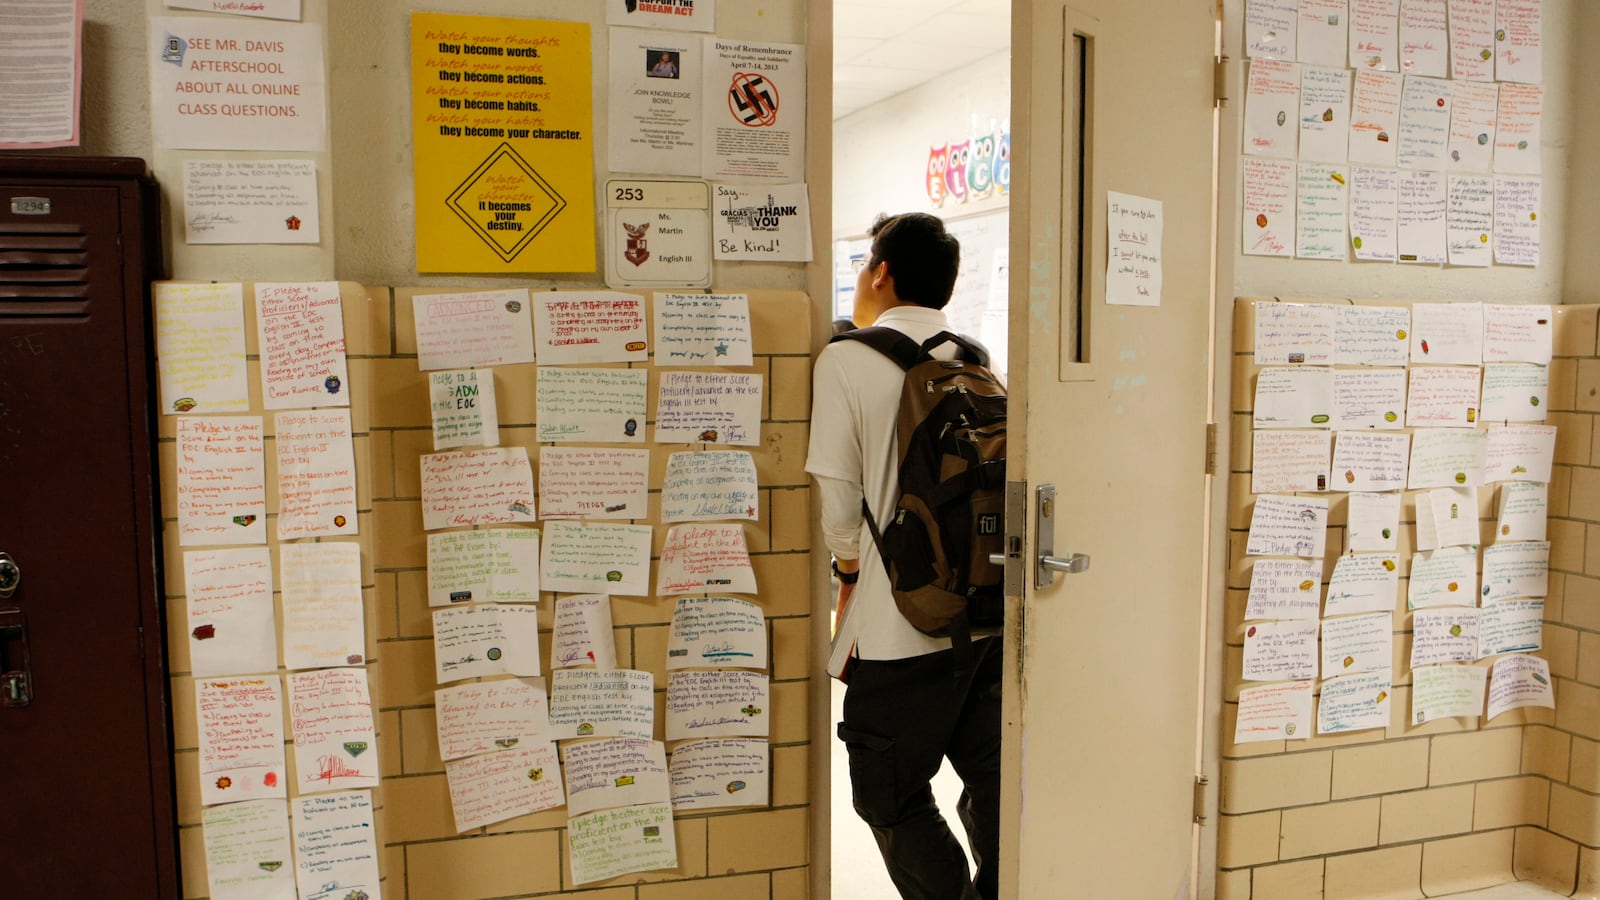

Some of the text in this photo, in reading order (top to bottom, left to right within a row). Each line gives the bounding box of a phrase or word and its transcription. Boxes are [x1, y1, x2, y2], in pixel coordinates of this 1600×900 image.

[639, 3, 694, 16] DREAM ACT
[188, 38, 284, 53] SEE MR. DAVIS
[425, 30, 560, 48] Watch your thoughts,
[439, 42, 540, 58] they become words.
[716, 42, 792, 56] Days of Remembrance
[190, 60, 285, 74] AFTERSCHOOL
[425, 58, 544, 74] Watch your words,
[748, 62, 762, 71] 7-14,
[439, 70, 547, 86] they become actions.
[176, 81, 300, 96] ABOUT ALL ONLINE
[426, 86, 552, 102] Watch your actions,
[650, 90, 691, 99] KNOWLEDGE
[178, 104, 300, 118] CLASS QUESTIONS.
[440, 98, 541, 112] they become habits.
[426, 113, 544, 130] Watch your habits,
[440, 126, 582, 140] they become your character.
[486, 174, 524, 184] Watch
[492, 185, 520, 194] your
[616, 188, 644, 201] 253
[718, 186, 748, 200] Say...
[478, 192, 535, 202] character,
[479, 201, 531, 212] it becomes
[758, 206, 797, 216] THANK
[495, 212, 516, 220] your
[754, 217, 779, 227] YOU
[488, 221, 524, 231] destiny.
[720, 239, 780, 253] Be Kind!
[1113, 248, 1118, 256] I
[659, 255, 684, 264] English
[264, 288, 272, 298] I
[456, 398, 476, 410] EOC
[694, 398, 706, 406] test
[620, 822, 631, 830] on
[634, 818, 650, 827] the
[655, 816, 666, 824] AP
